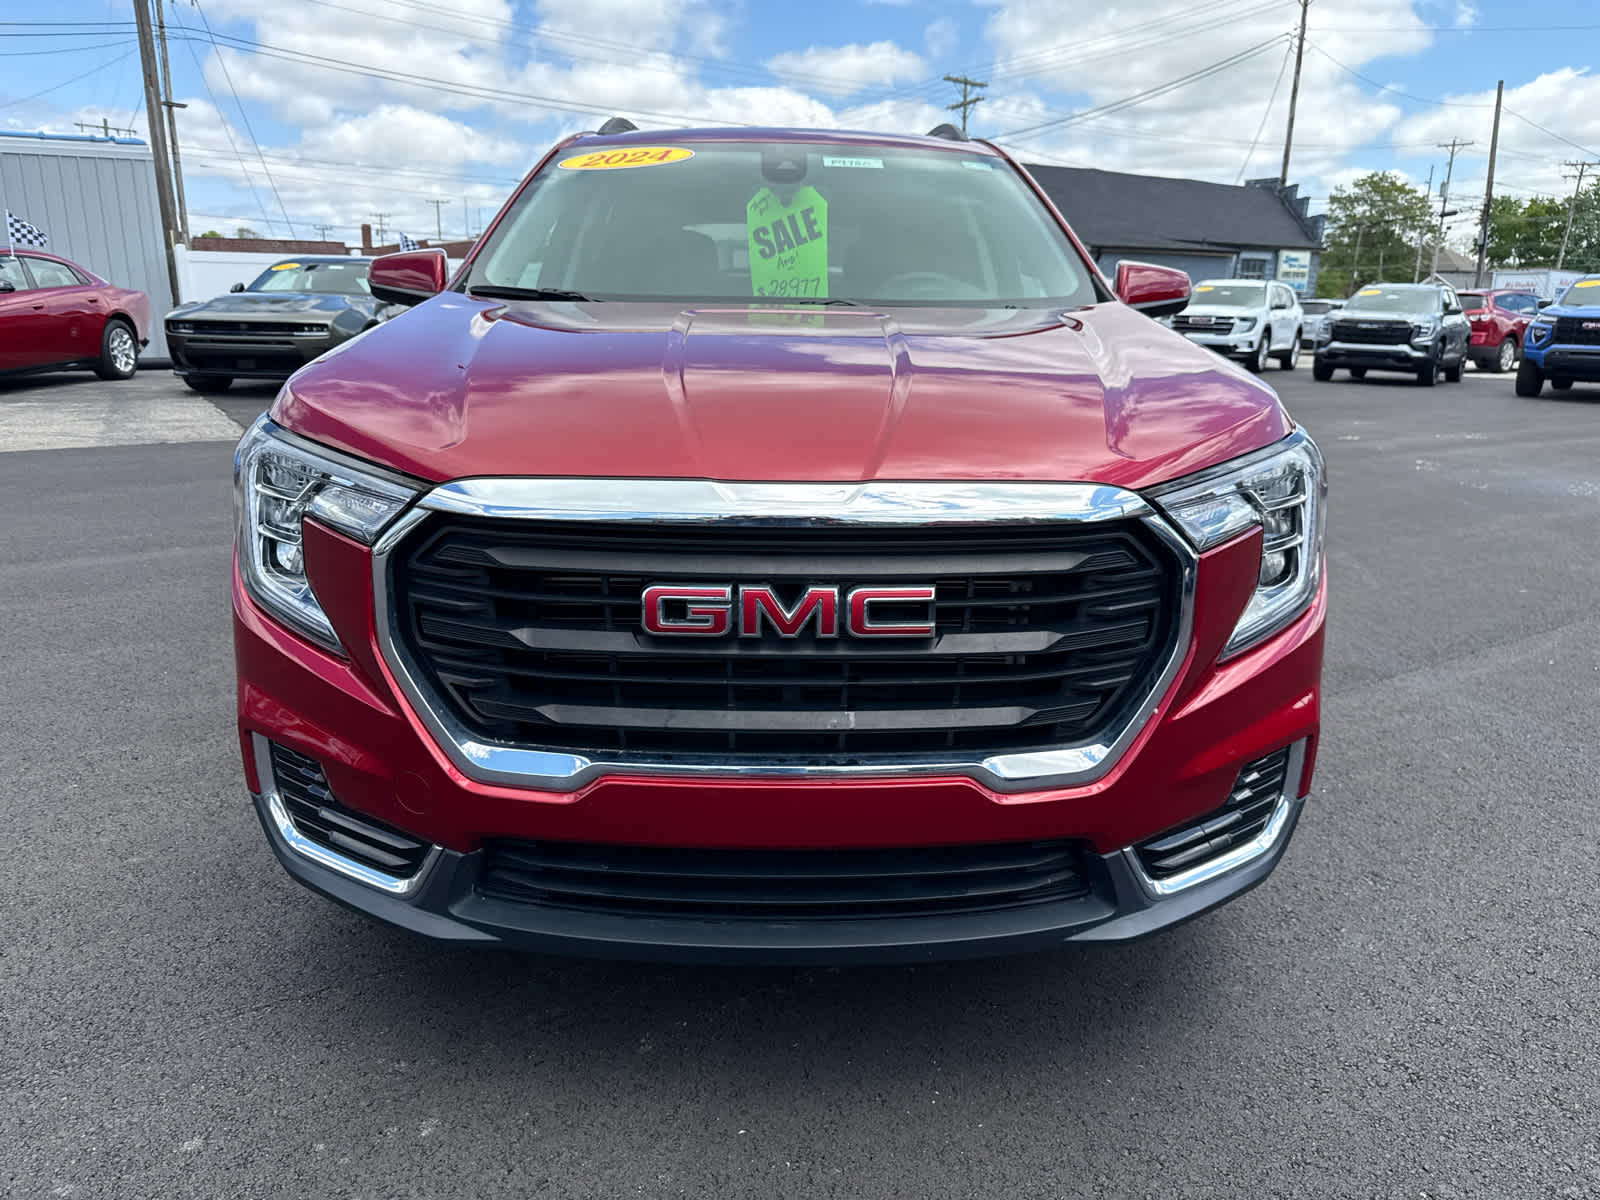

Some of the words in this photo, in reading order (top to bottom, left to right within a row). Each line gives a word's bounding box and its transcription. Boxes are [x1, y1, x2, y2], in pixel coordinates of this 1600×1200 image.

[580, 150, 672, 167] 2024
[753, 207, 823, 259] SALE
[641, 584, 937, 638] GMC
